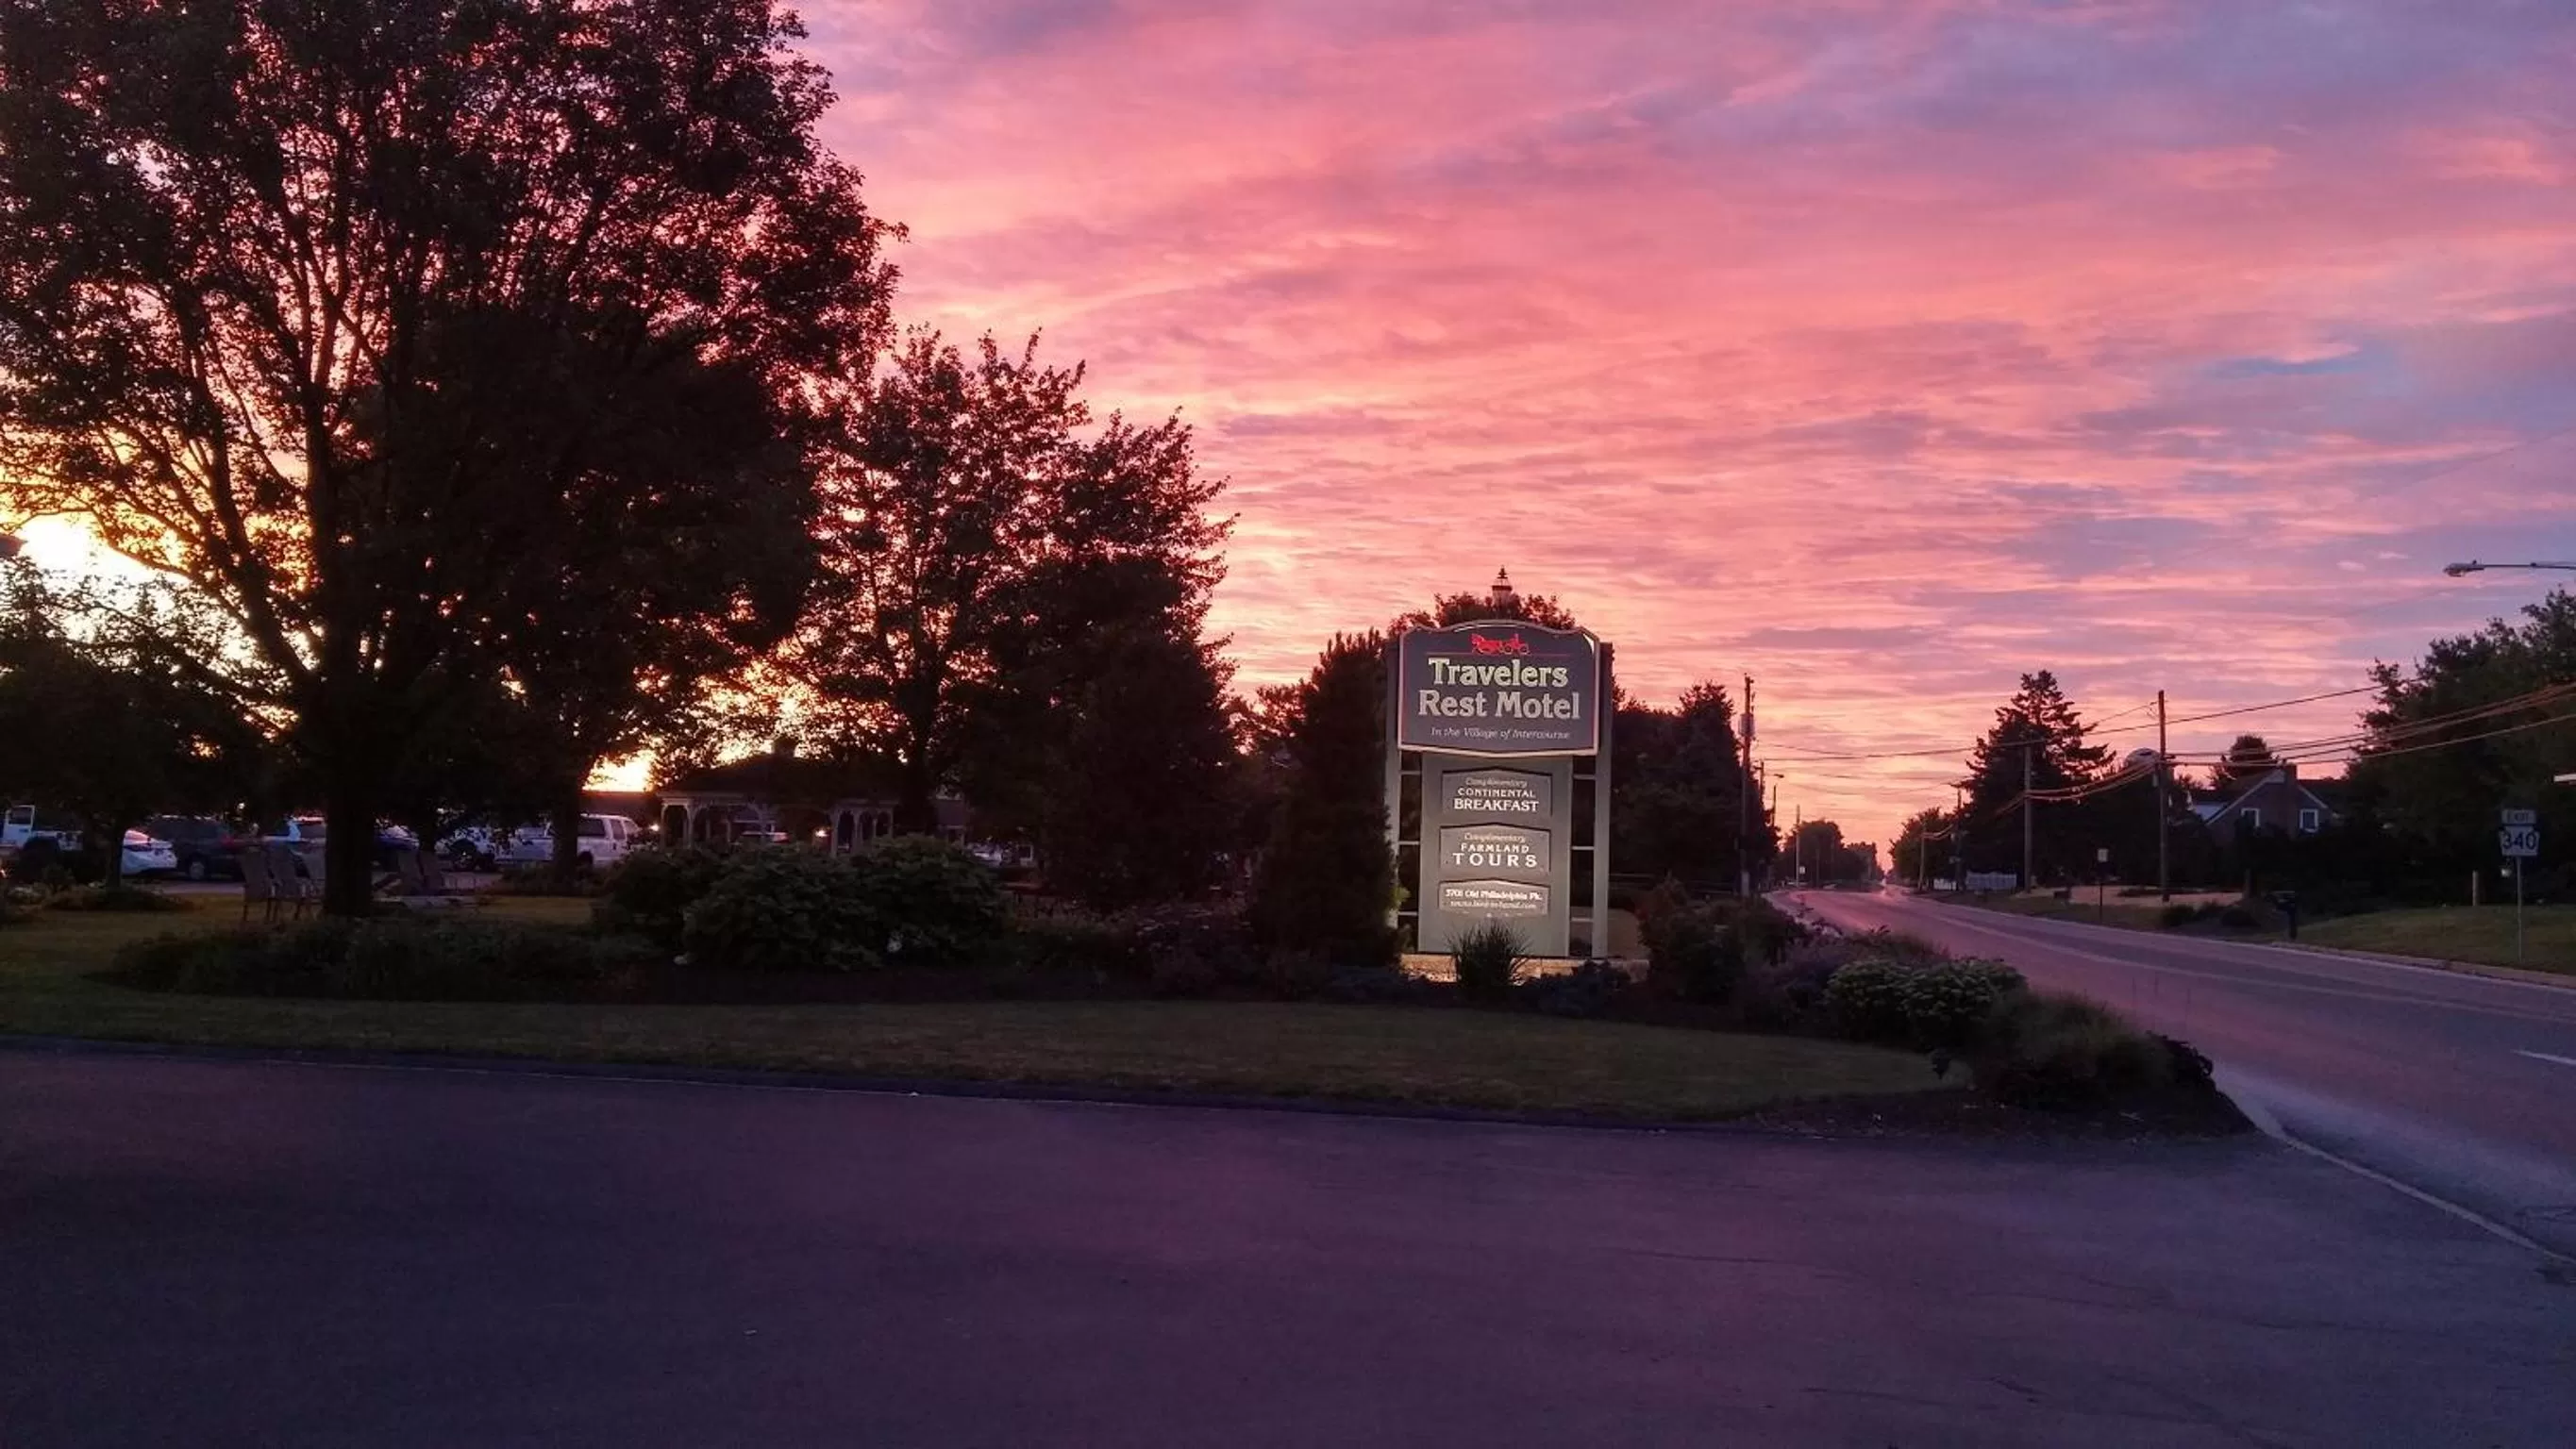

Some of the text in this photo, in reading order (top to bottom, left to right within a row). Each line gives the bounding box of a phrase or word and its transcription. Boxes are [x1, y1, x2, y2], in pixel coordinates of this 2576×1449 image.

[1428, 658, 1568, 688] Travelers
[1418, 690, 1581, 720] Rest Motel
[1430, 727, 1570, 740] In the Village of Intercourse
[1458, 788, 1536, 798] CONTINENTAL
[1454, 798, 1539, 812] BREAKFAST
[1461, 842, 1530, 854] FARMLAND
[2502, 831, 2537, 850] 340
[1452, 852, 1537, 868] TOURS
